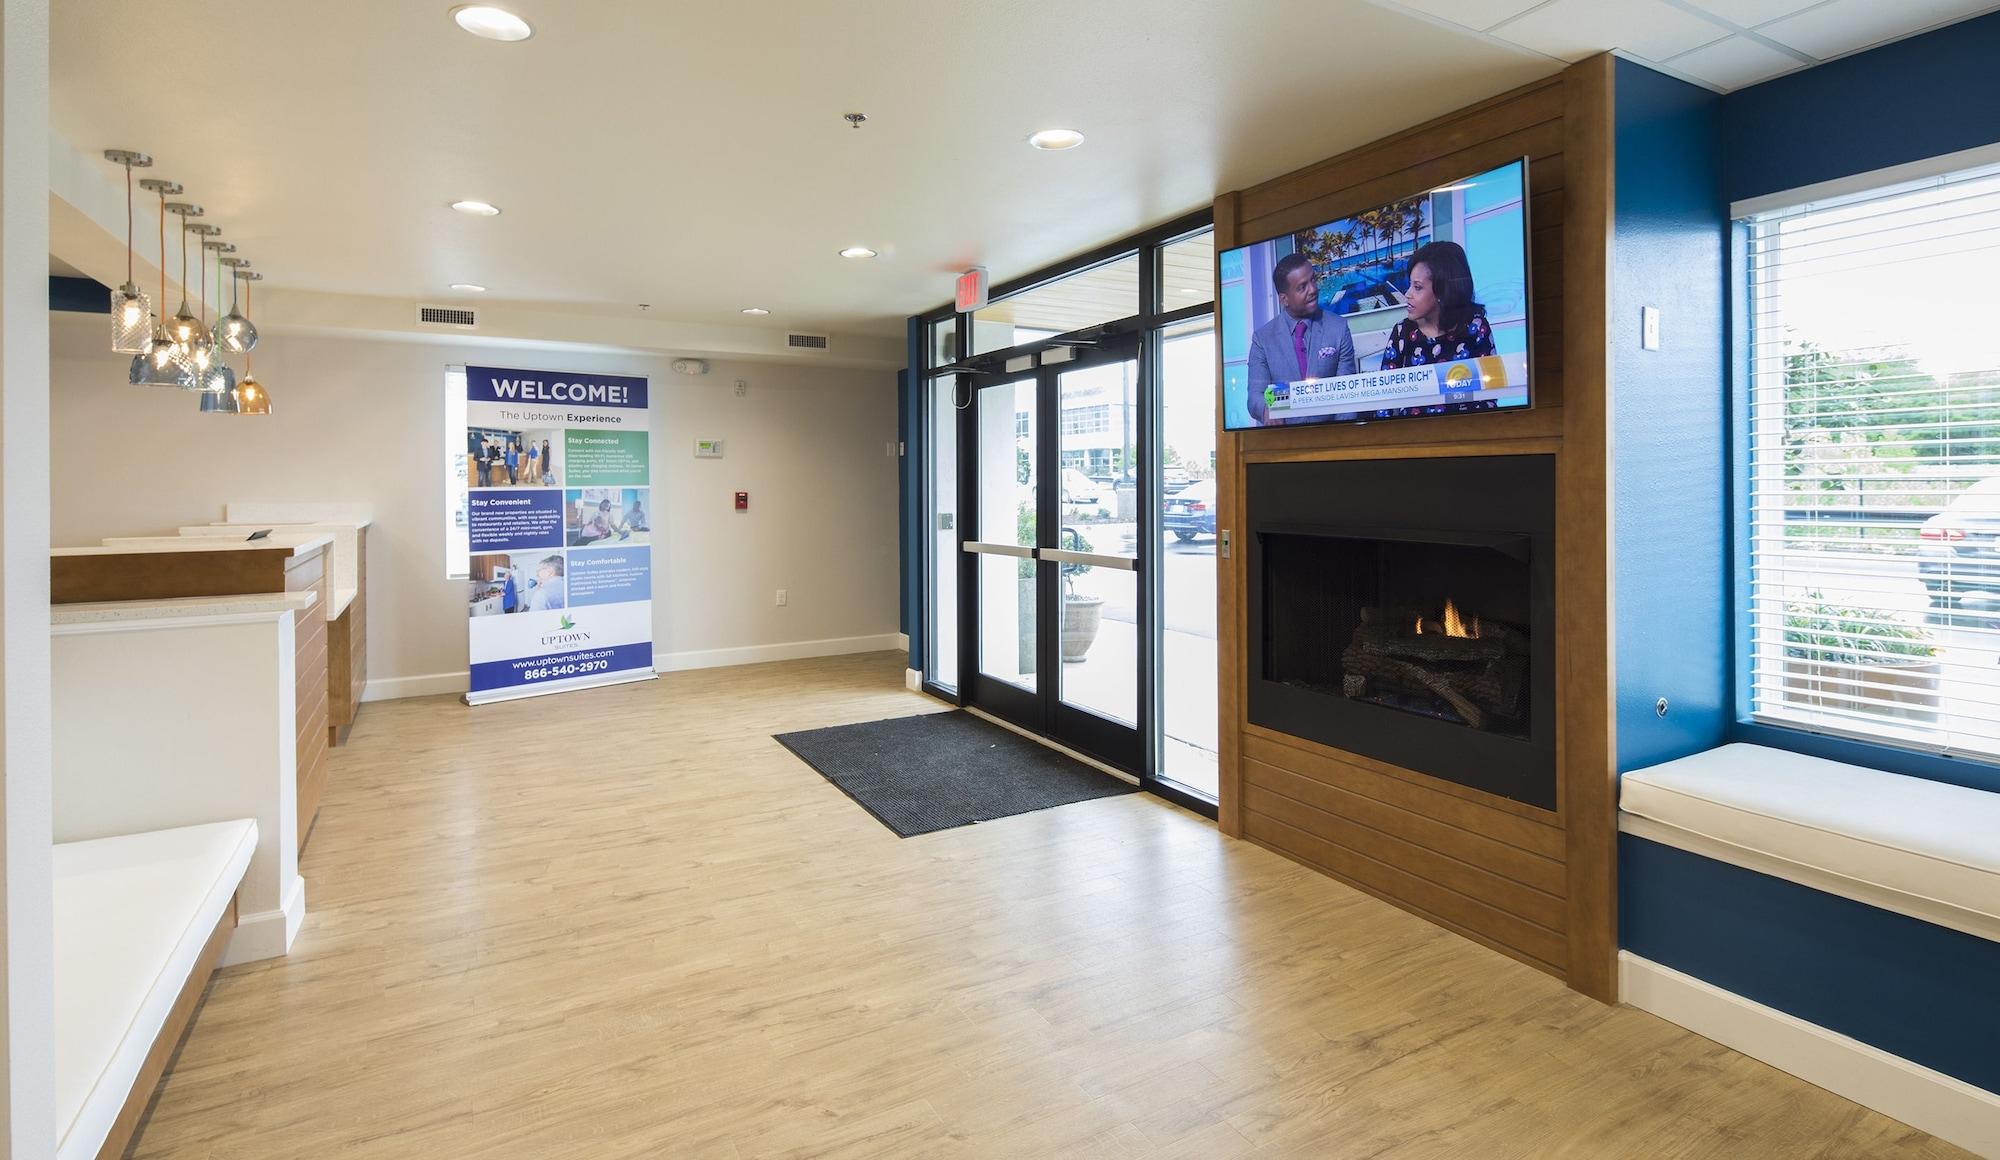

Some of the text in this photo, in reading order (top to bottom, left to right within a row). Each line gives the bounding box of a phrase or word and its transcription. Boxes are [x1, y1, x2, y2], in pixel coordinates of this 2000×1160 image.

[491, 378, 628, 403] WELCOME!
[1326, 381, 1346, 392] LIVES
[1349, 380, 1359, 389] OF
[1362, 378, 1376, 387] THE
[1380, 375, 1406, 386] SUPER
[1446, 378, 1472, 388] TODAY
[1361, 385, 1419, 397] MEGA-MANSIONS
[500, 411, 621, 423] The Uptown Experience
[541, 632, 590, 645] UPTOWN
[513, 649, 614, 669] www.uptownsuites.com
[524, 660, 608, 680] 866-540-2970
